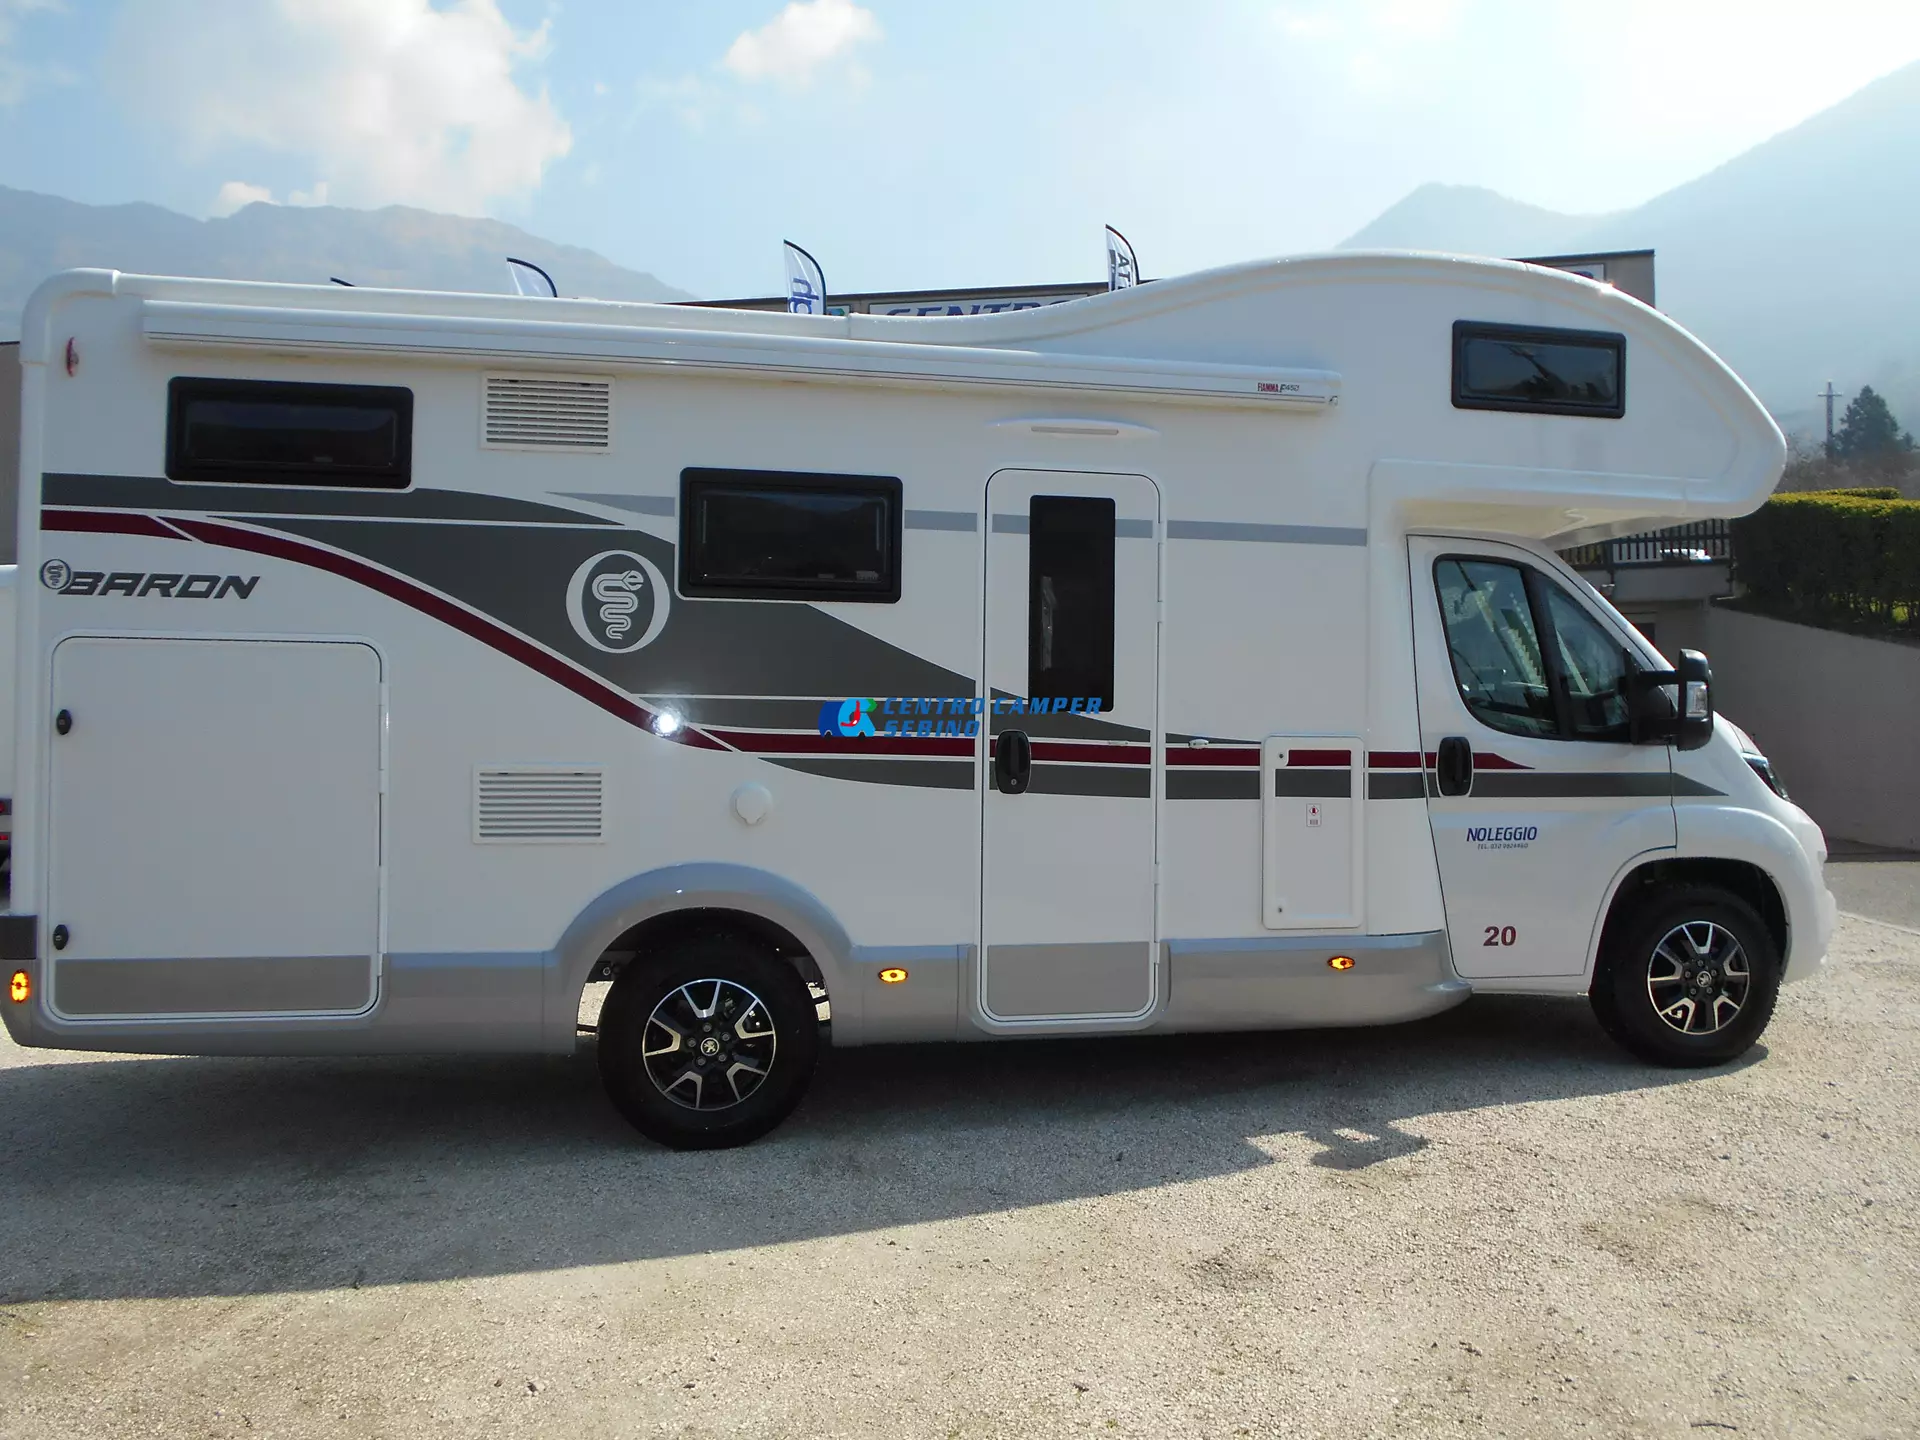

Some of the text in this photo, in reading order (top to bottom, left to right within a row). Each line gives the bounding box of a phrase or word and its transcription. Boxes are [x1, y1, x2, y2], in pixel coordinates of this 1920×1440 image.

[57, 571, 261, 600] BARON
[1466, 826, 1538, 842] NOLEGGIO
[1483, 925, 1517, 946] 20
